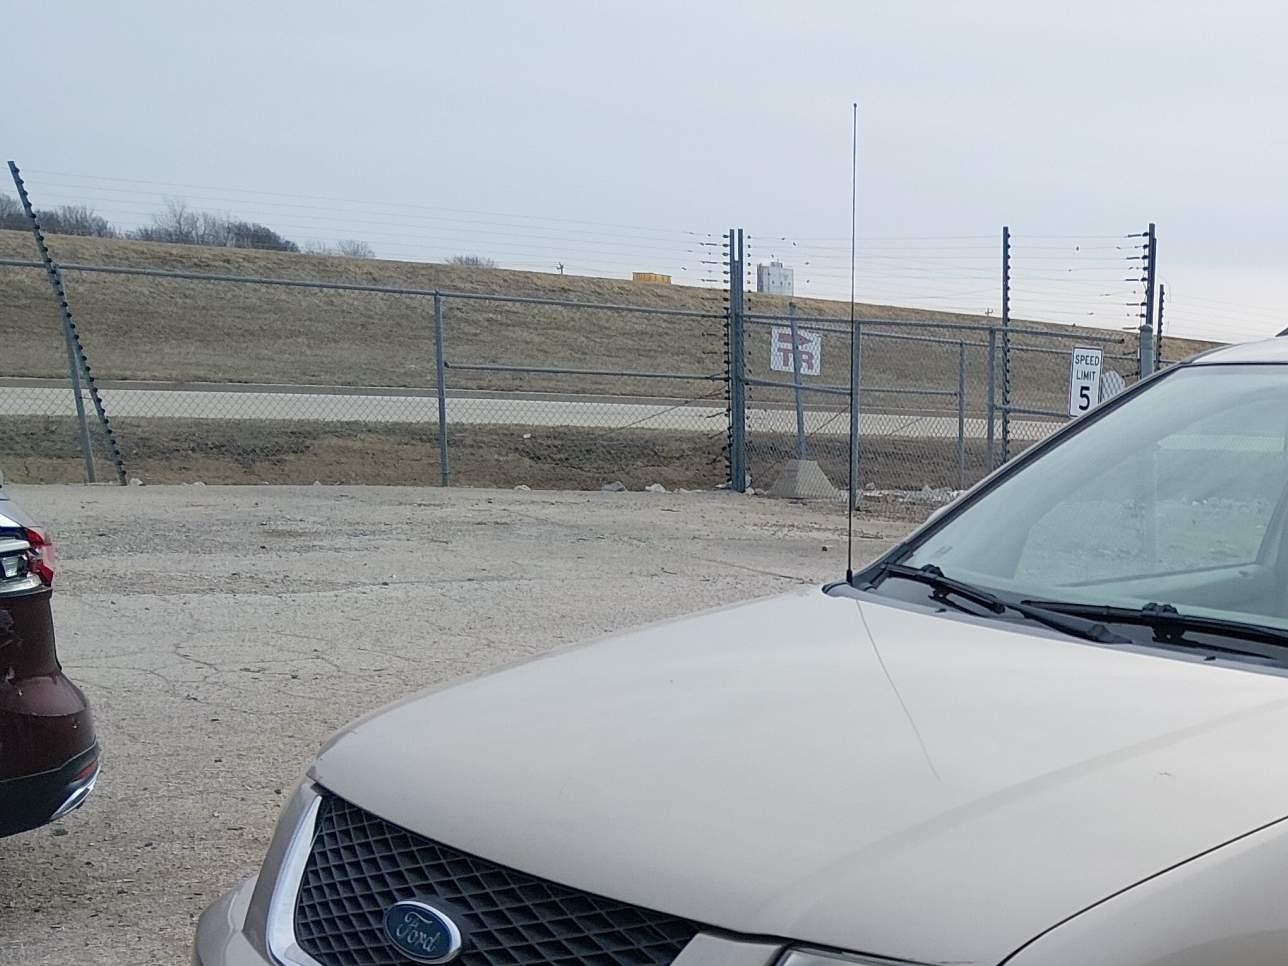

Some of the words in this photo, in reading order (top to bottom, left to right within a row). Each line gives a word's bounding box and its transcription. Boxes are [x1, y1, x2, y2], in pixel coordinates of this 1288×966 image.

[1075, 354, 1100, 366] SPEED
[1076, 369, 1096, 382] LIMIT
[1079, 386, 1090, 411] 5
[396, 911, 441, 952] Ford
